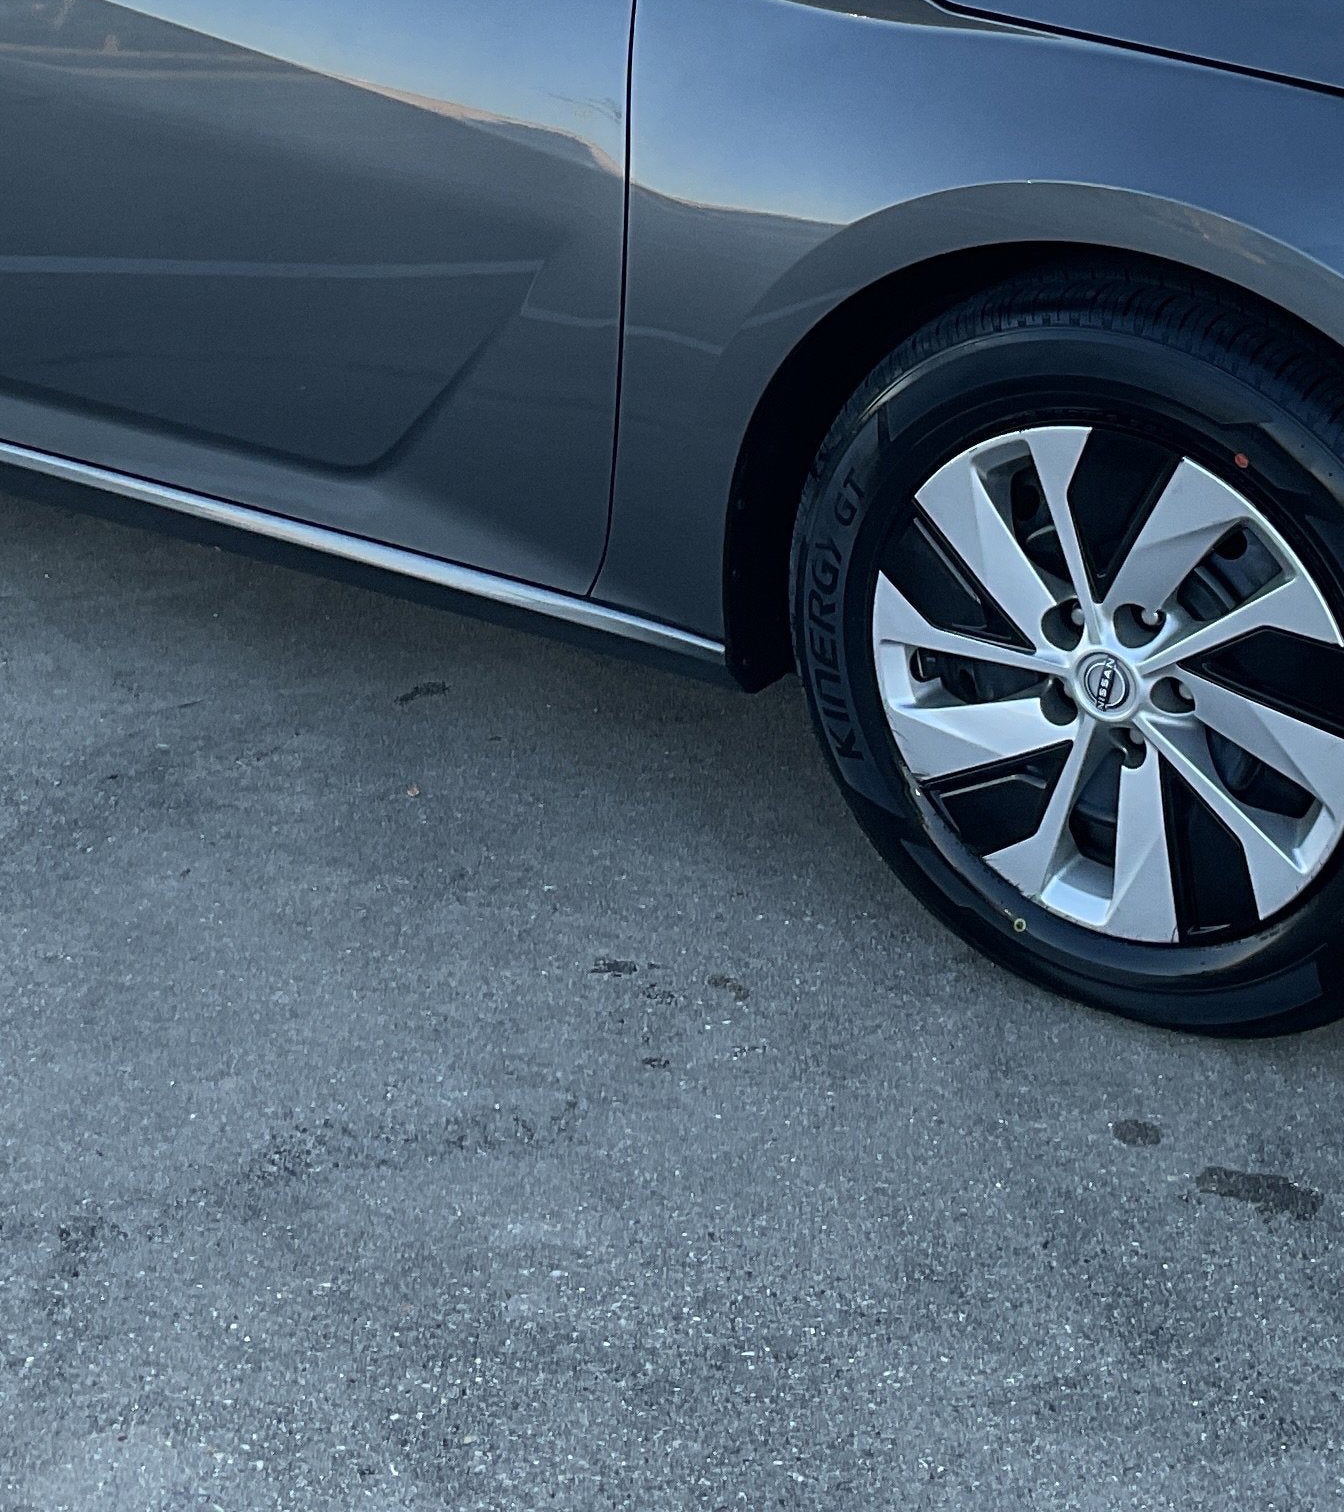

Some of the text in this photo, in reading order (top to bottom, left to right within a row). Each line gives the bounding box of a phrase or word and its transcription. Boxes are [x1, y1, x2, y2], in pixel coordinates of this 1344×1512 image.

[808, 467, 866, 762] KINERGY GT
[1097, 657, 1115, 710] NISSAN
